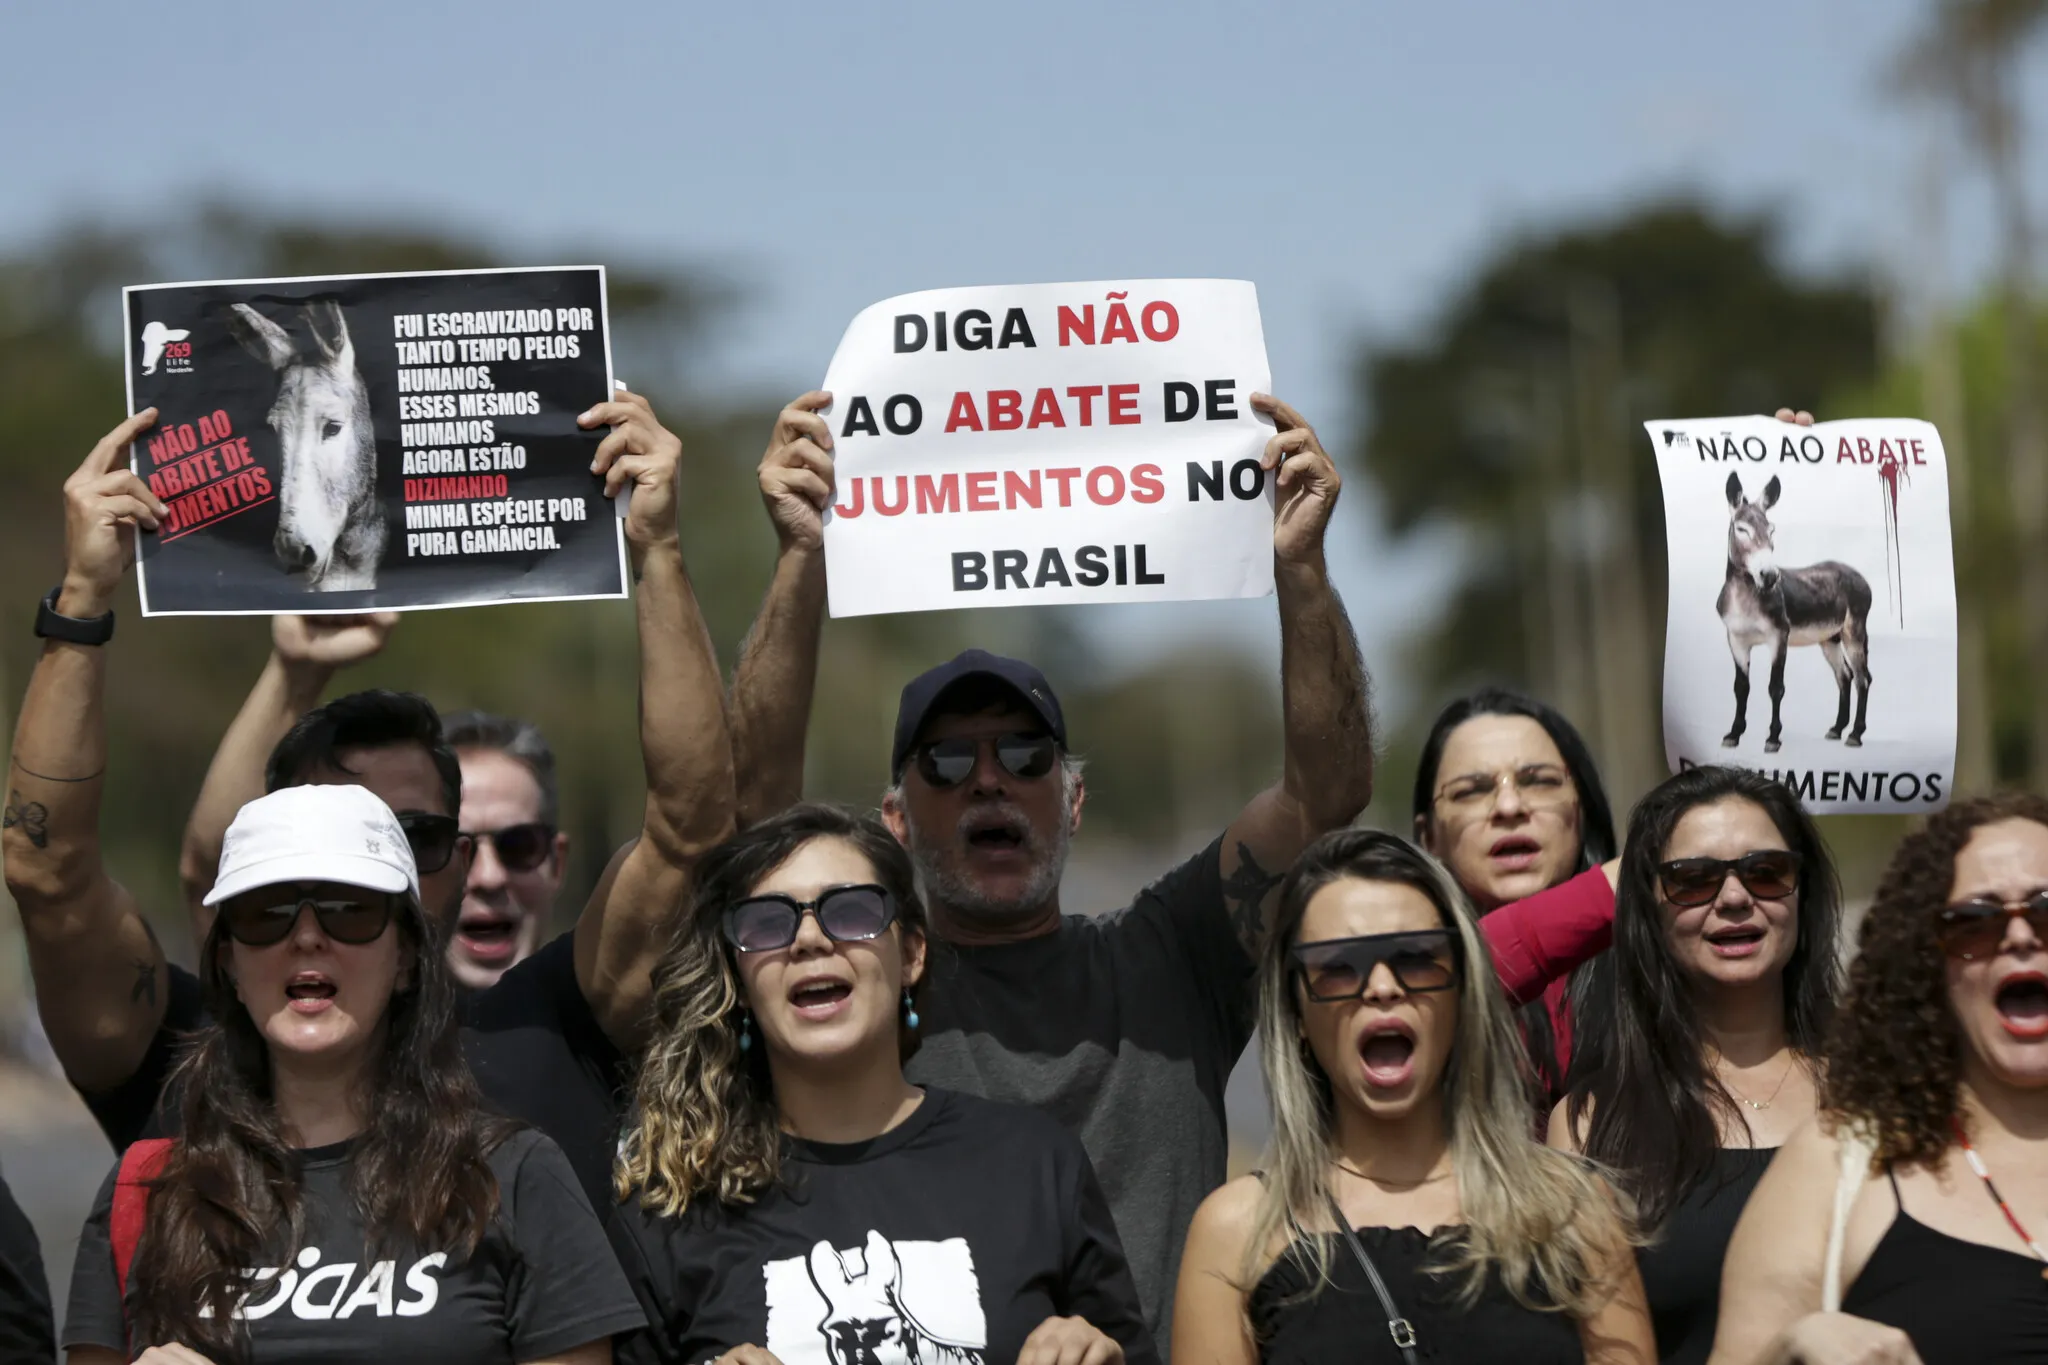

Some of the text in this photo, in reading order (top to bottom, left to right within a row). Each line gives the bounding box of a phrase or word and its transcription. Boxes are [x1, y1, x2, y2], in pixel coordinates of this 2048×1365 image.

[394, 308, 594, 338] FUI ESCRAVIZADO POR
[893, 291, 1180, 354] DIGA NÃO
[165, 342, 192, 358] 269
[395, 335, 581, 365] TANTO TEMPO PELOS
[398, 366, 495, 392] HUMANOS,
[400, 391, 540, 420] ESSES MESMOS
[841, 379, 1238, 437] AO ABATE DE
[148, 409, 232, 465] NÃO AO
[401, 420, 495, 447] HUMANOS
[1696, 431, 1767, 462] NÃO
[1780, 435, 1824, 463] AO
[1836, 437, 1926, 465] ABATE
[148, 437, 255, 500] ABATE DE
[403, 443, 527, 474] AGORA ESTÃO
[157, 467, 272, 537] UMENTOS
[404, 474, 508, 502] DIZIMANDO
[834, 458, 1265, 519] JUMENTOS NO
[405, 497, 586, 529] MINHA ESPÉCIE POR
[407, 524, 561, 557] PURA GANÂNCIA.
[951, 544, 1165, 591] BRASIL
[1745, 768, 1942, 802] MENTOS
